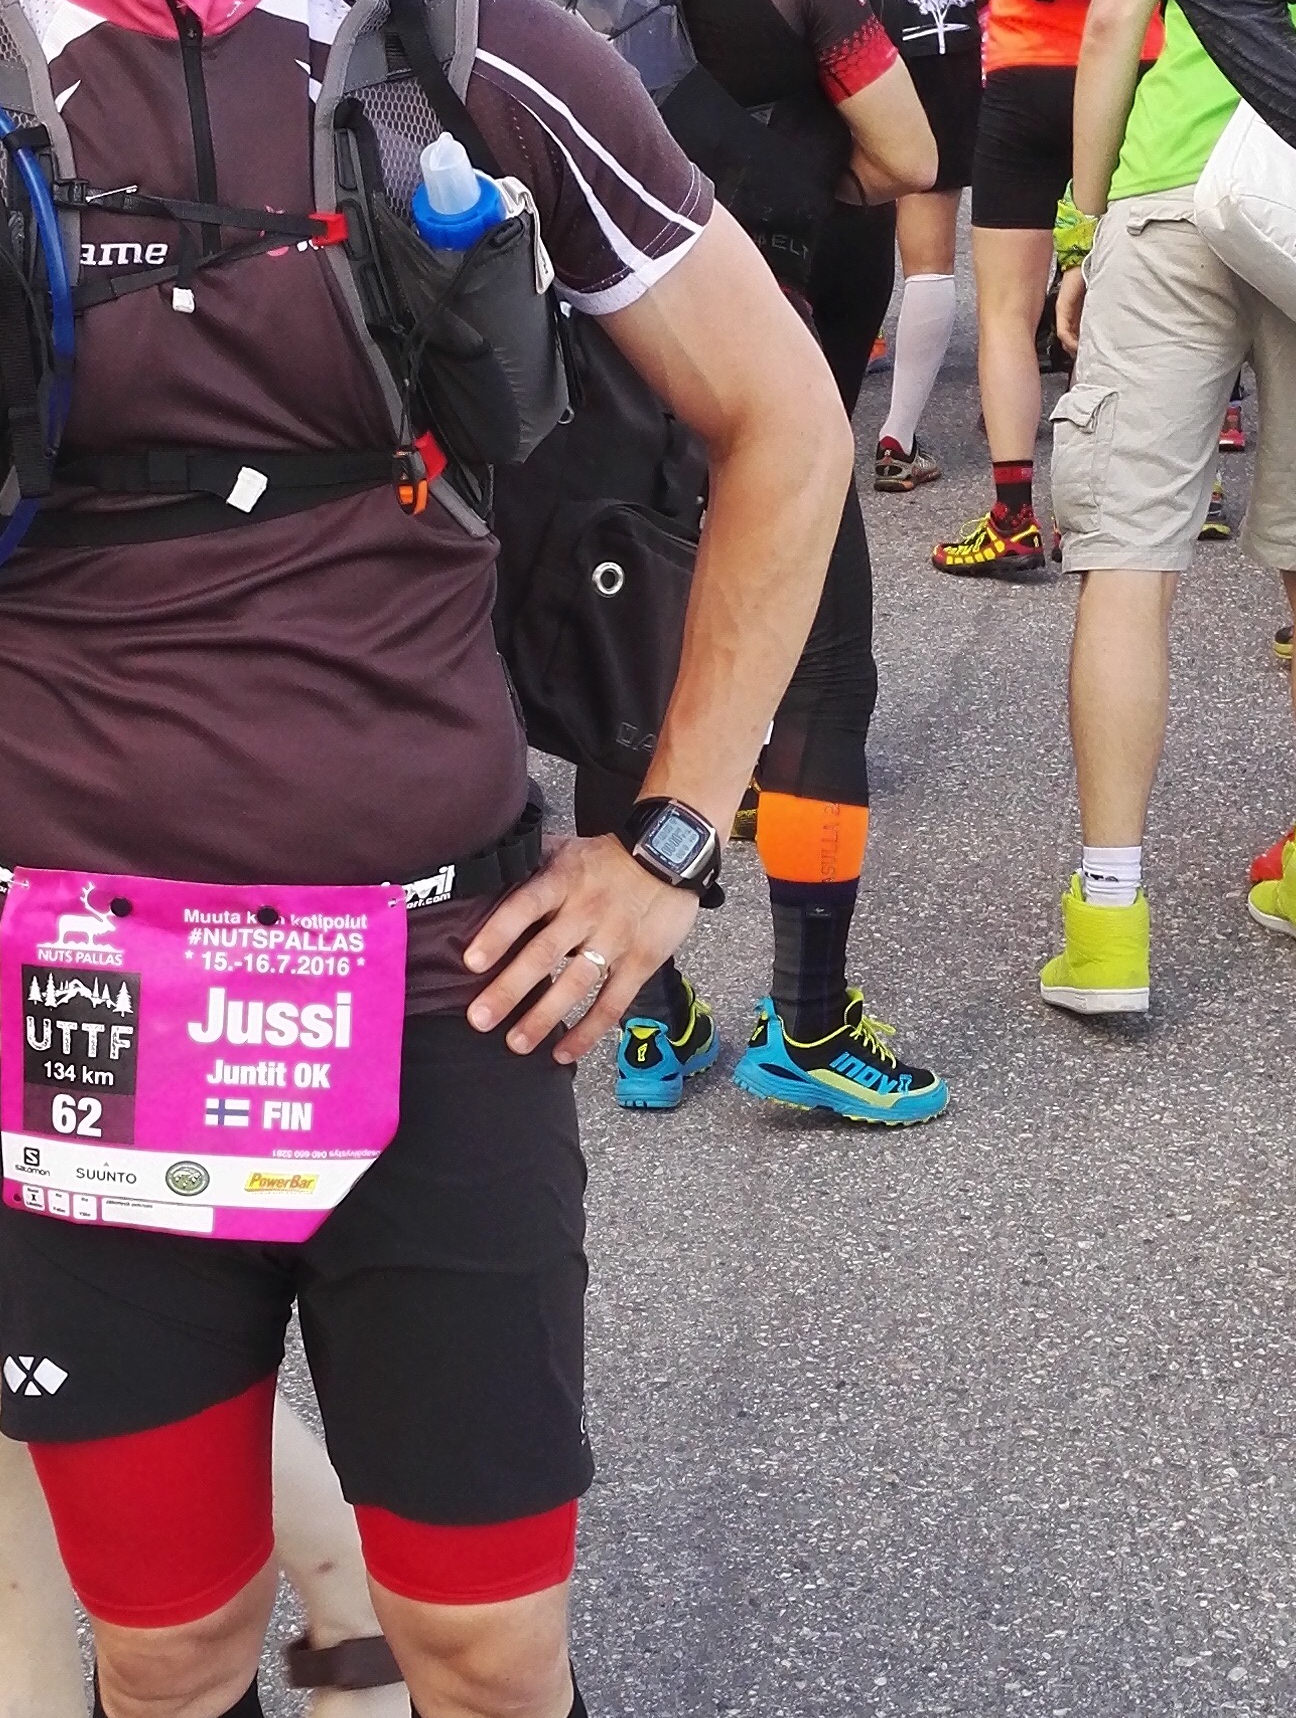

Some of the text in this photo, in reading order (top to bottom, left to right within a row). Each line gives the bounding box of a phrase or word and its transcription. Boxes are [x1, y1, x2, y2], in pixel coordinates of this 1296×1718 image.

[184, 908, 368, 932] Muuta kn kotipolut
[188, 928, 365, 952] #NUTSPALLAS
[37, 948, 123, 967] NUTS PALLAS
[202, 951, 350, 976] 15.-16.7.2016
[187, 987, 352, 1048] Jussi
[26, 1016, 134, 1060] UTTF
[43, 1060, 114, 1086] 134 km
[206, 1059, 331, 1089] Juntit OK
[51, 1093, 102, 1137] 62
[263, 1100, 312, 1130] FIN
[14, 1164, 51, 1177] salomon
[76, 1167, 137, 1184] SUUNTO
[249, 1172, 314, 1190] PowerBar
